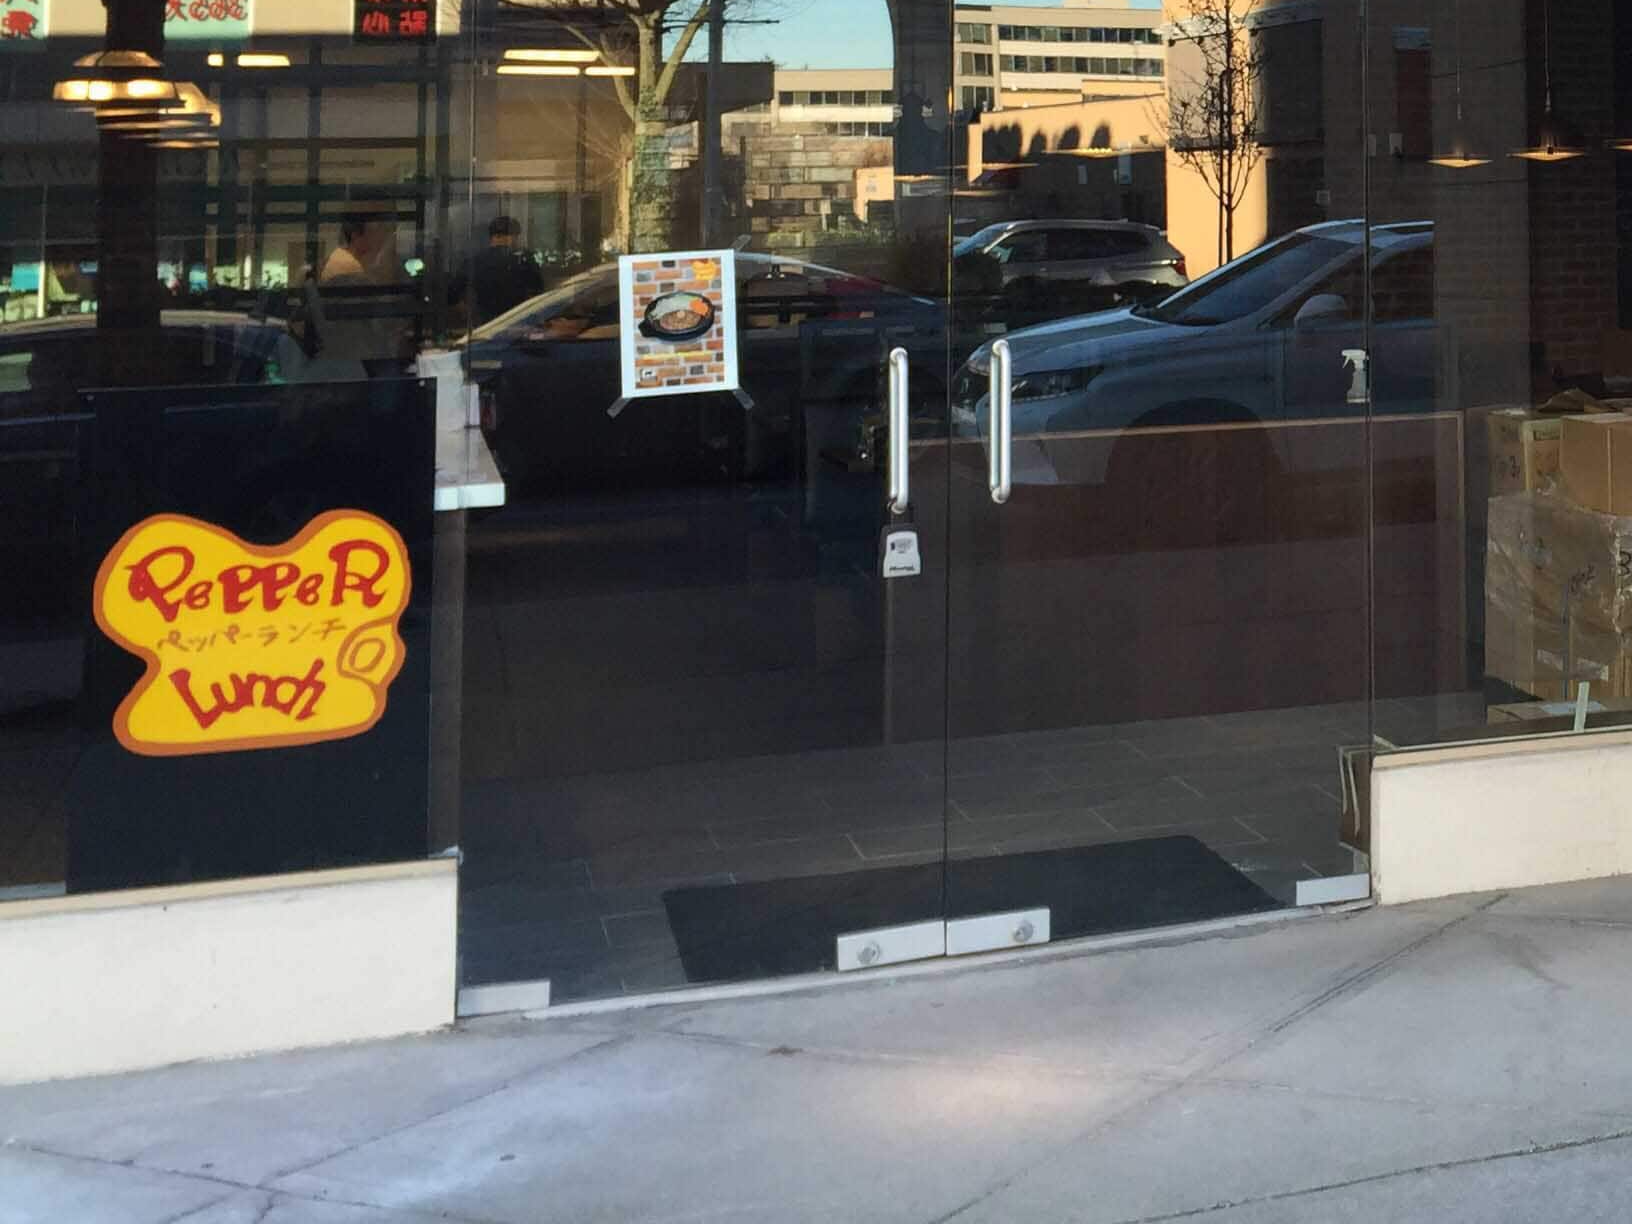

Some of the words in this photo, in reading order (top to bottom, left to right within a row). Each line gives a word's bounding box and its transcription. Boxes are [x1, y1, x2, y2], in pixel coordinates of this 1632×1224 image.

[156, 618, 347, 653] ペッパーランチ
